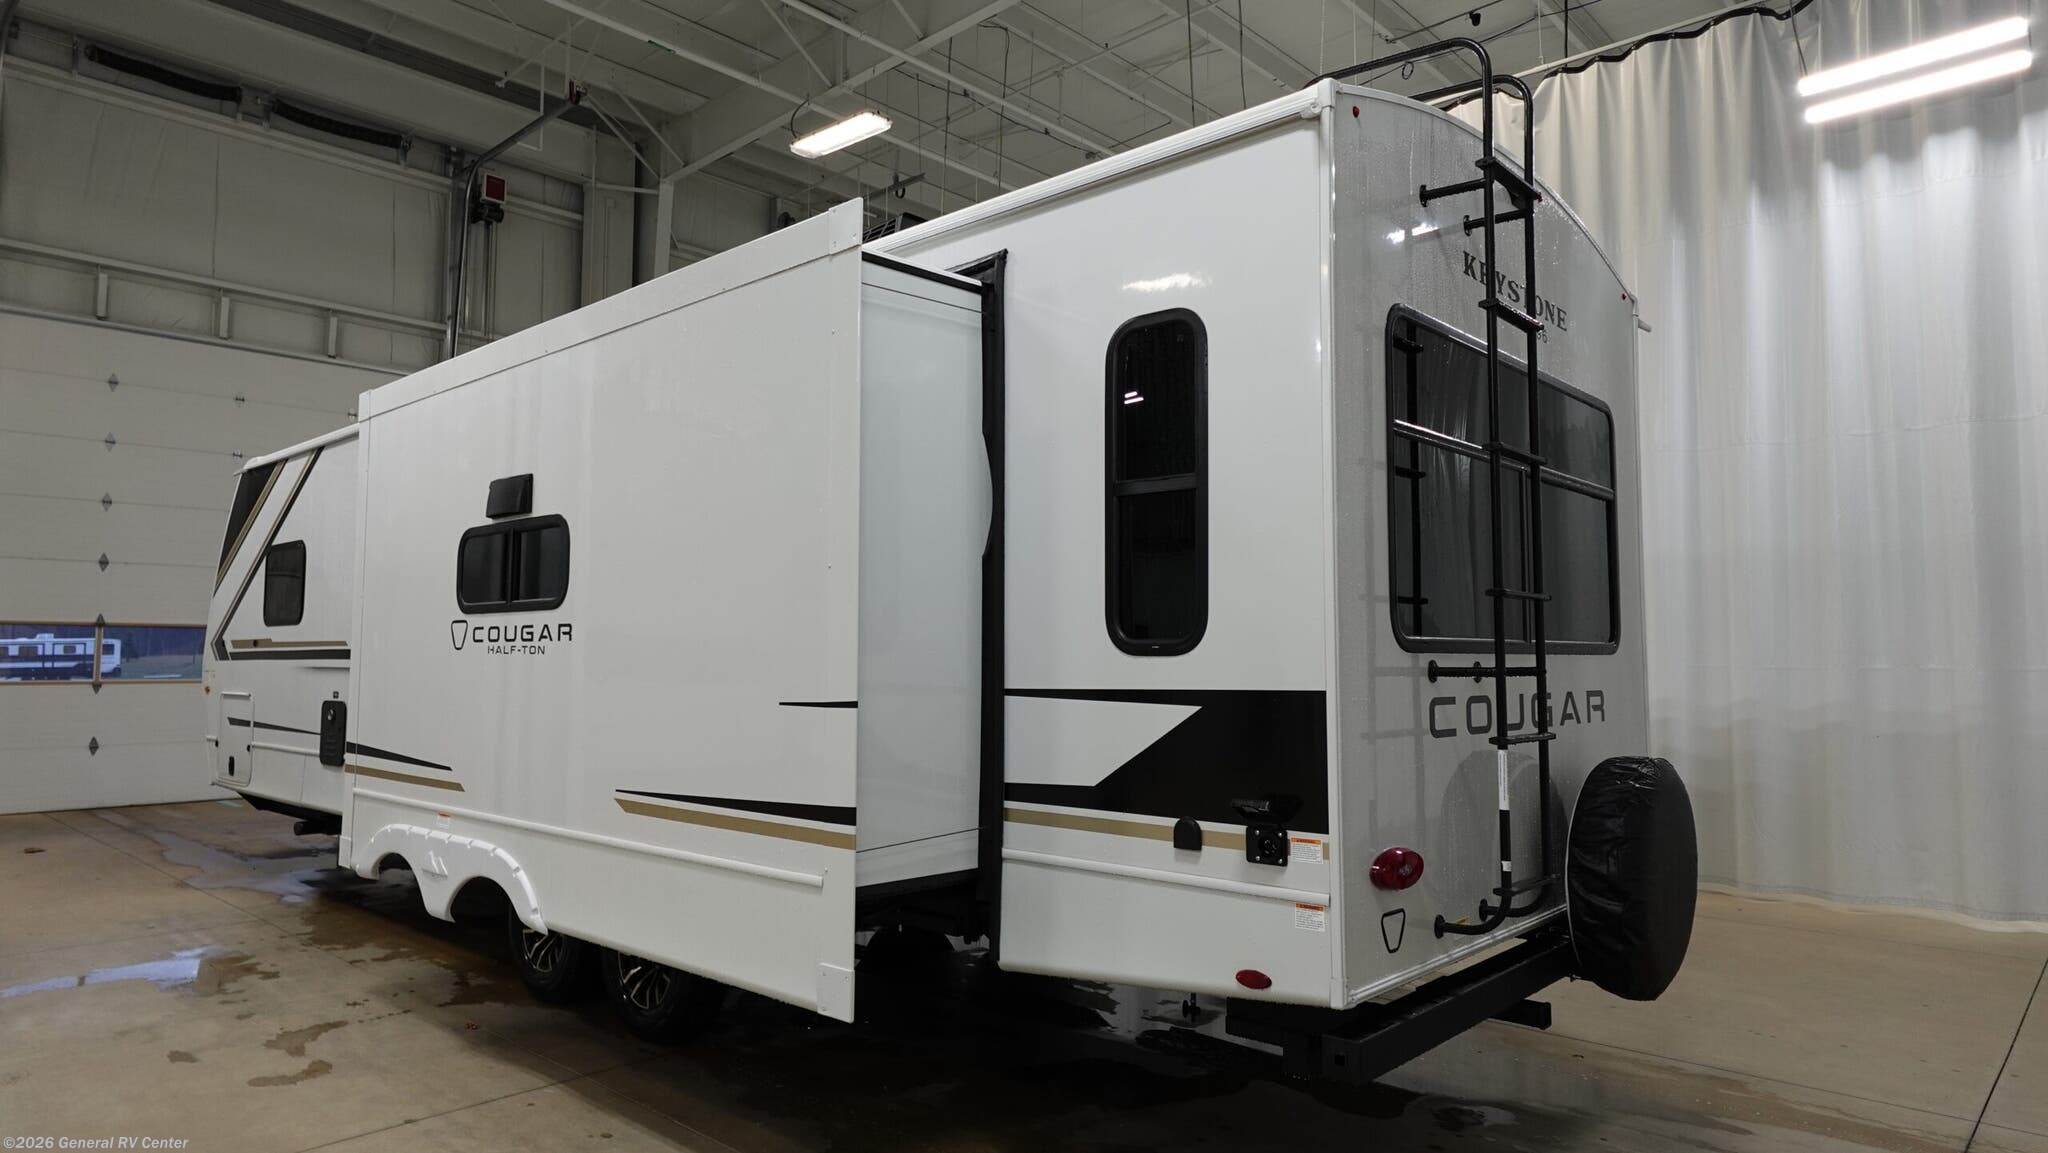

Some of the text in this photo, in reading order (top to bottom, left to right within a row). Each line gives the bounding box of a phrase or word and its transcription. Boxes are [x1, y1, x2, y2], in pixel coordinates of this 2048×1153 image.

[1463, 250, 1568, 331] KEYSONE
[472, 623, 573, 643] COUGAR
[487, 645, 546, 655] HALF-TON
